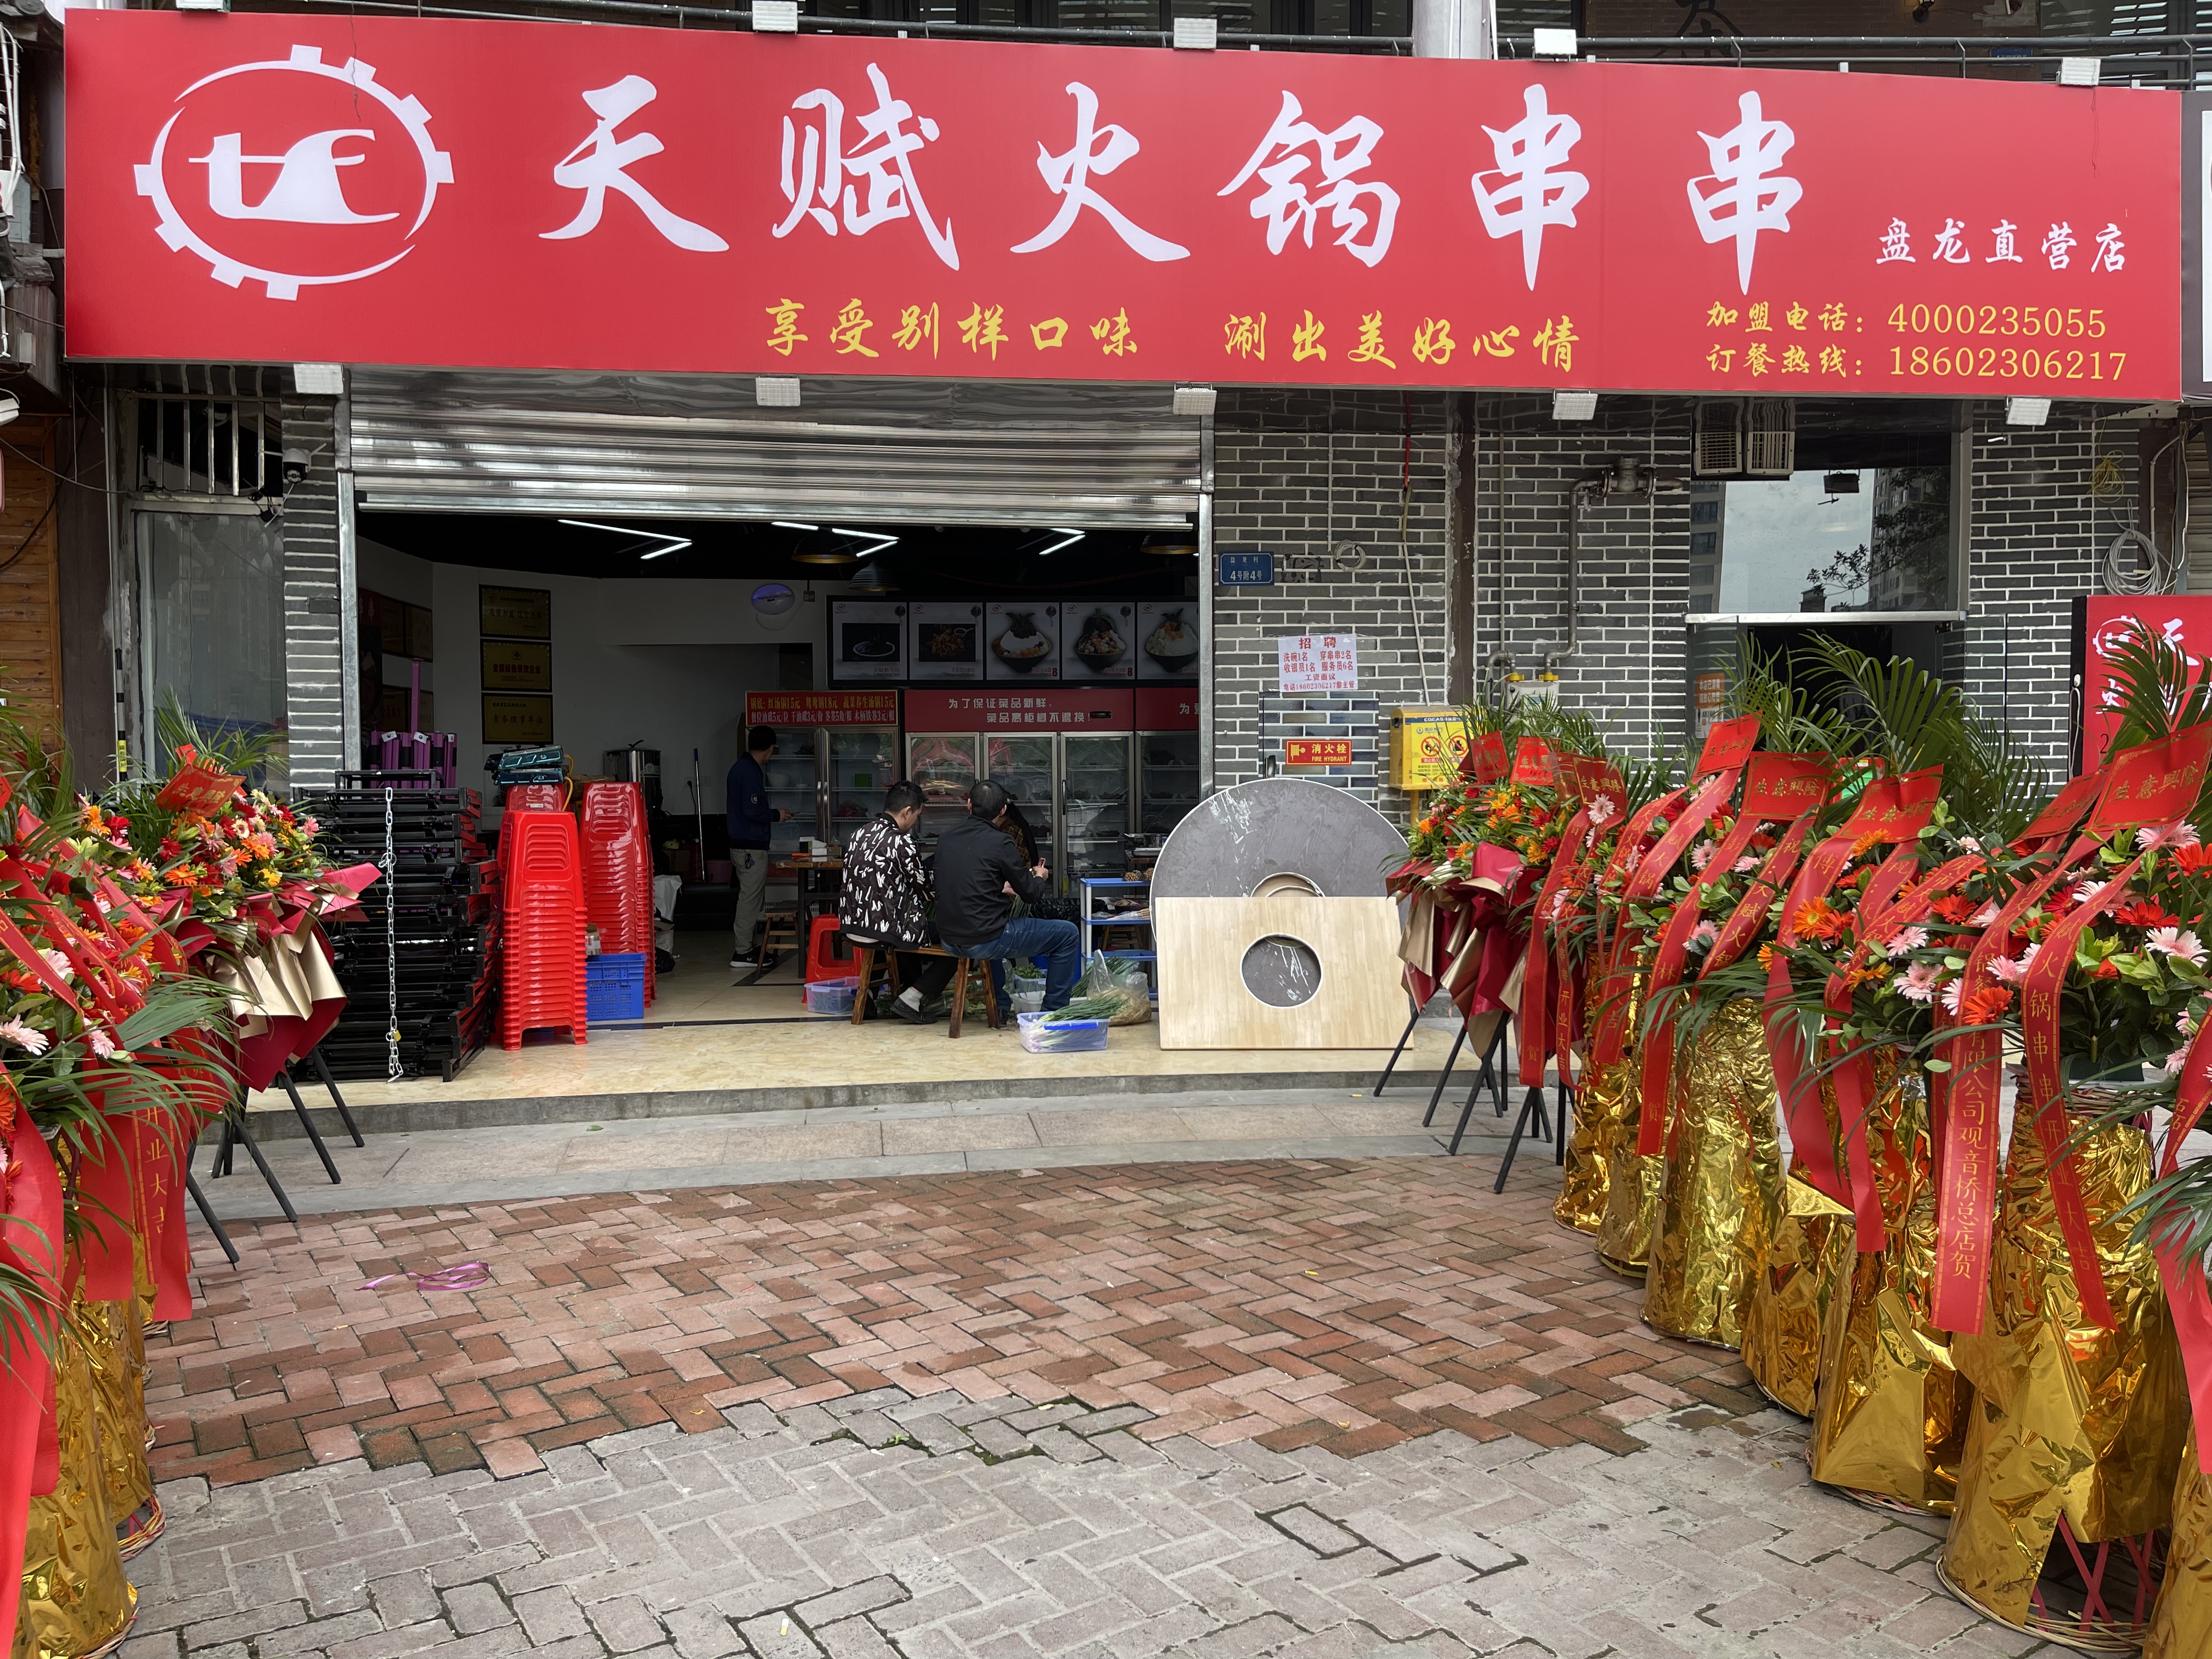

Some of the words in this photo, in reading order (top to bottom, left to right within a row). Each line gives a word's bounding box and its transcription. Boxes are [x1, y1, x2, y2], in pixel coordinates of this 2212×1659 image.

[539, 63, 1803, 295] 天赋火锅串串
[1875, 217, 2127, 273] 盘龙直营店
[766, 298, 1137, 360] 享受别样口味
[1224, 310, 1579, 373] 涮出美好心情
[1230, 570, 1262, 581] 4号附4号
[1283, 651, 1308, 662] 洗碗1名
[1320, 650, 1352, 661] 穿串串2名
[1284, 662, 1316, 673] 收银员1名
[1321, 661, 1353, 672] 服务员6名
[1305, 673, 1336, 681] 工资面议
[1311, 743, 1347, 754] 消火栓
